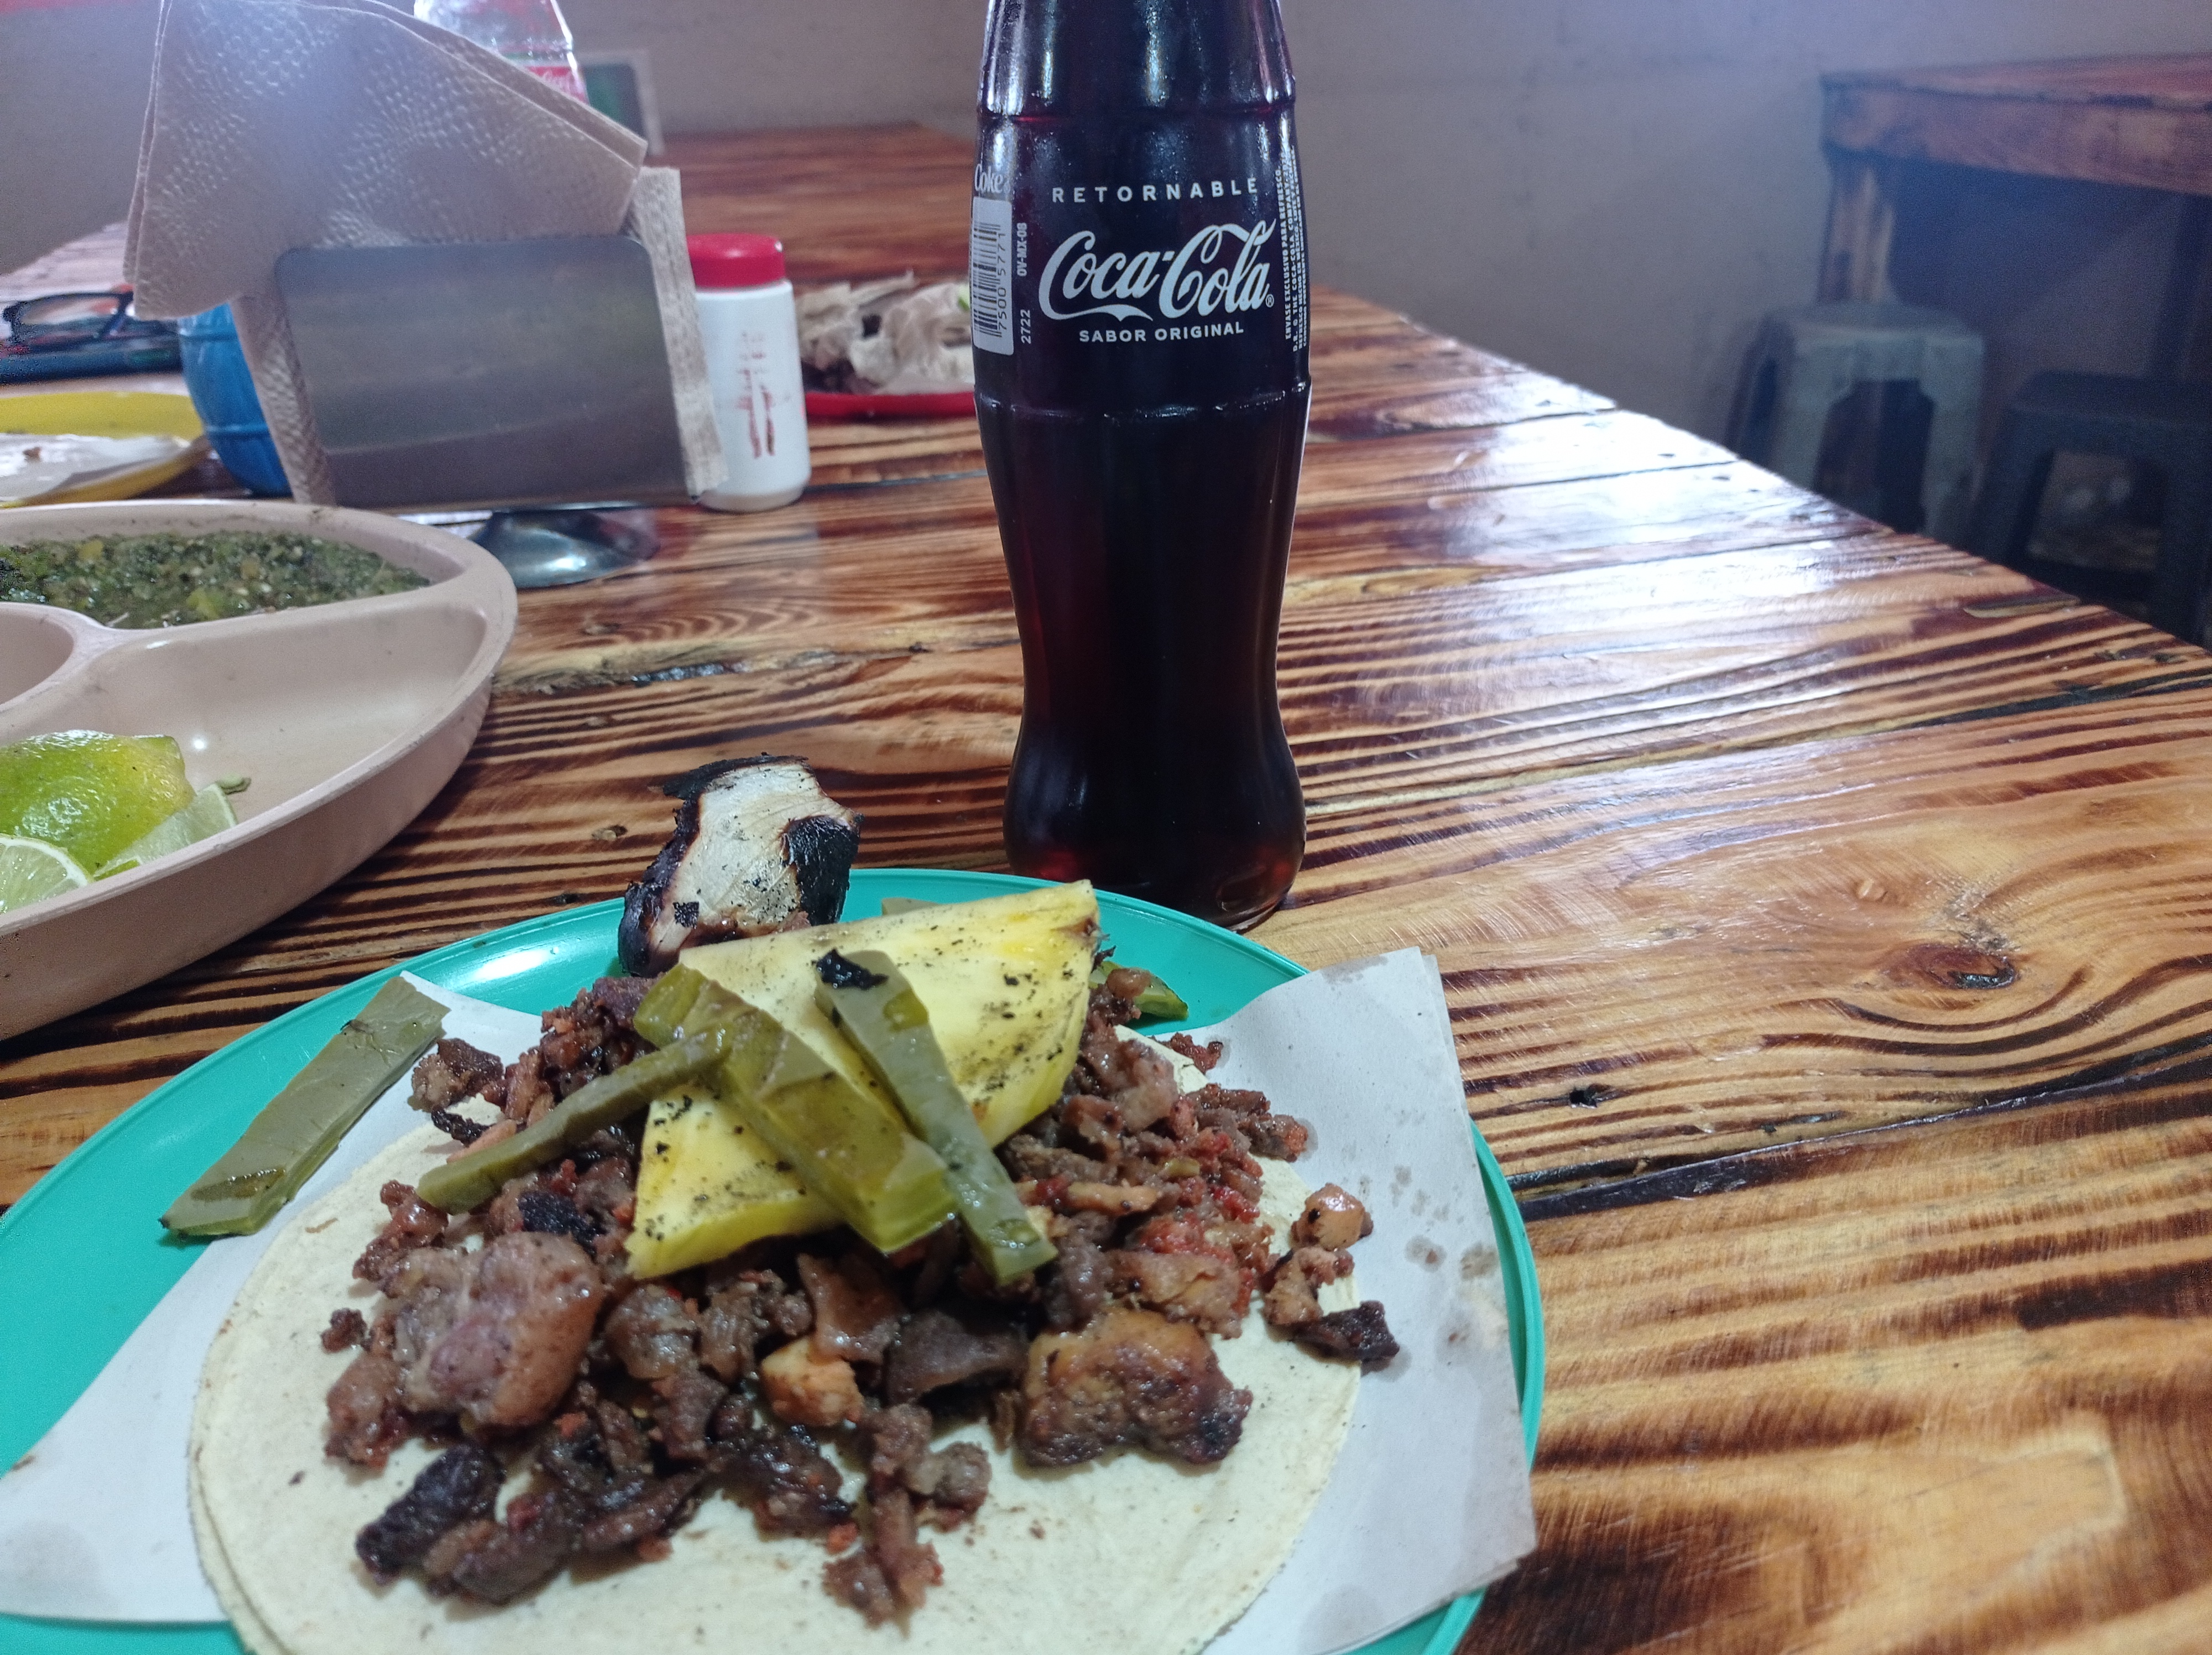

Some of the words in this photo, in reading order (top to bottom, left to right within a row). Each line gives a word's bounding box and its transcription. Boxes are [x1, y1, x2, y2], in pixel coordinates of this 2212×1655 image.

[974, 164, 1003, 193] Coke
[1052, 178, 1258, 203] RETORNABLE
[998, 233, 1006, 275] 5771
[1039, 218, 1276, 322] Coca-Cola
[1289, 235, 1297, 291] COCA-COLA
[1282, 249, 1291, 302] EXCLUSIVO
[998, 287, 1008, 331] 7500
[1020, 309, 1031, 344] 2722
[1079, 330, 1147, 343] SABOR
[1154, 321, 1244, 342] ORIGINAL
